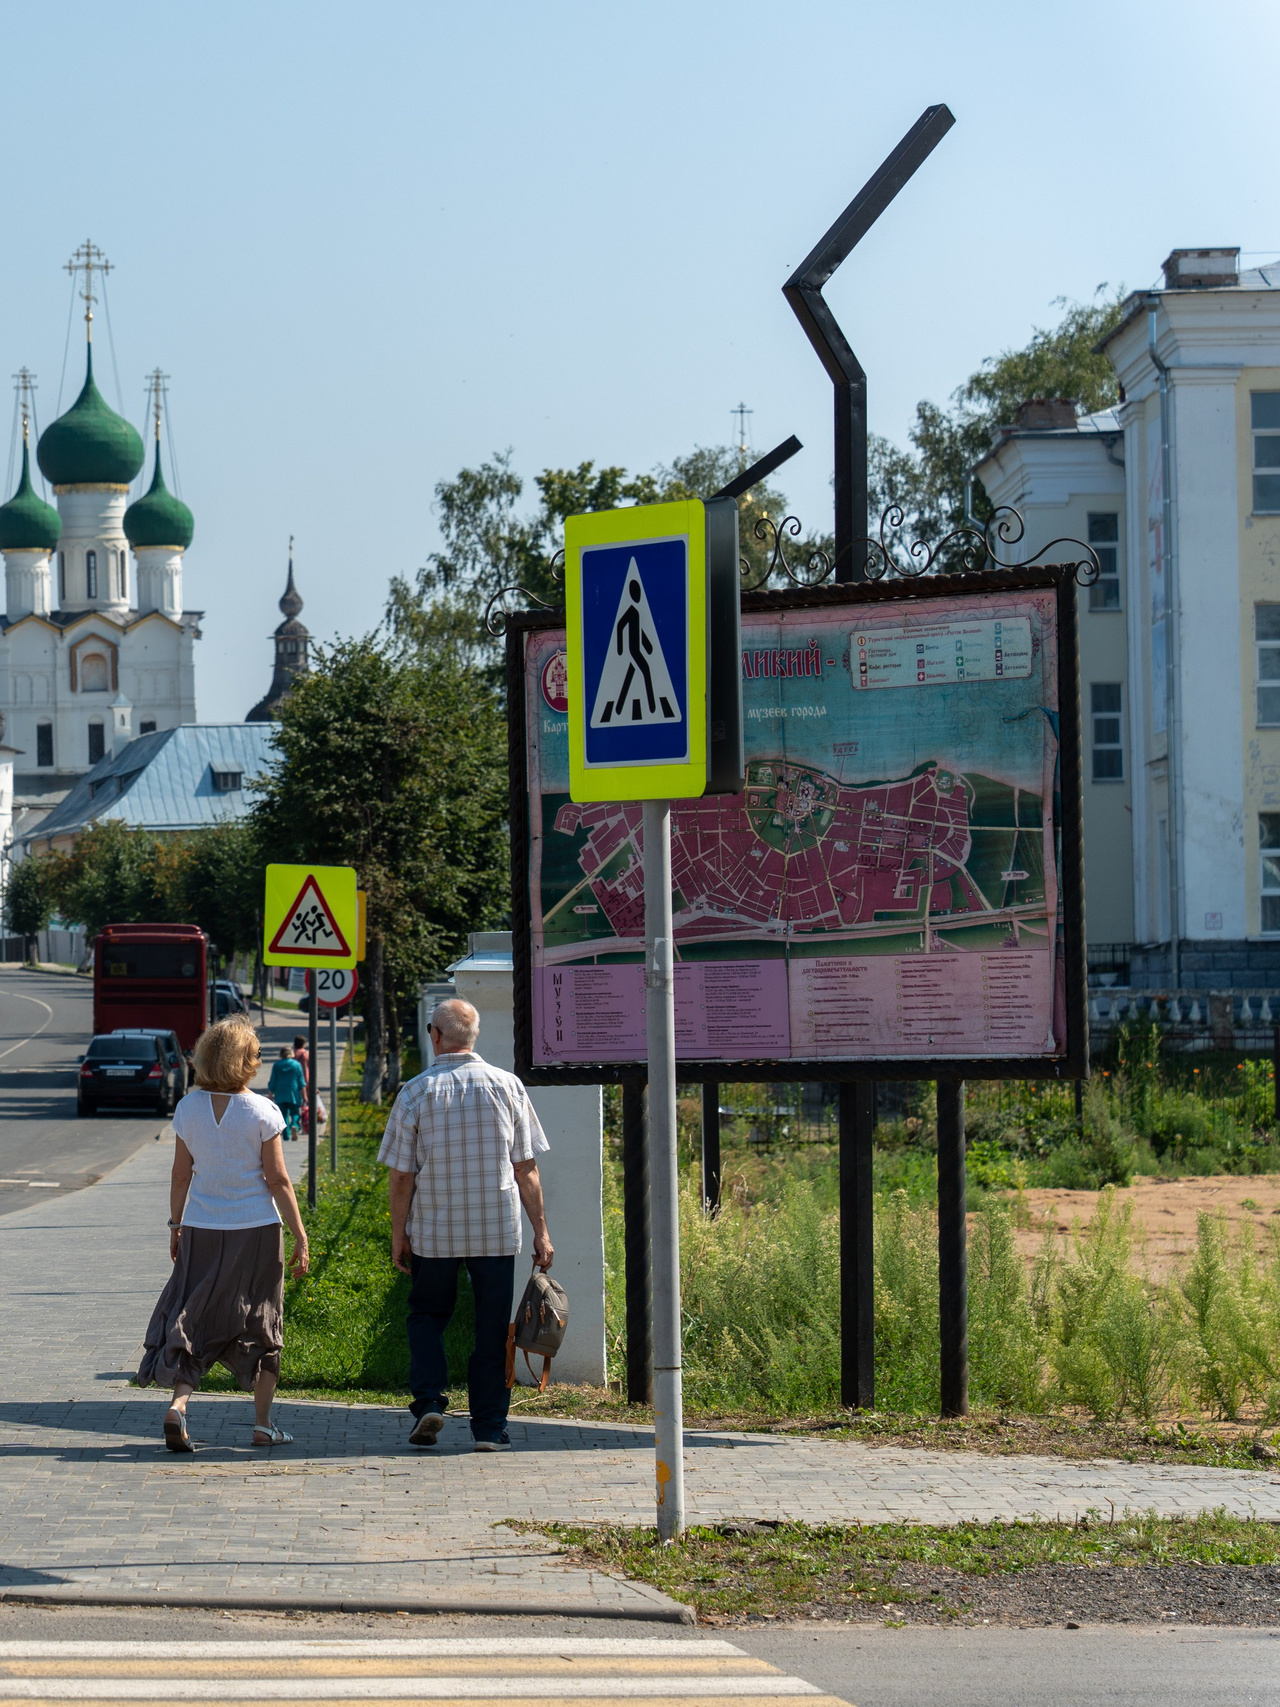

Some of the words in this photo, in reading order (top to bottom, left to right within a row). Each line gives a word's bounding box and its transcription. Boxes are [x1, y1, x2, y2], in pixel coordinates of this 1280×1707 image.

[543, 720, 568, 735] Карт
[748, 707, 788, 722] музеев
[791, 706, 827, 720] города
[318, 970, 345, 990] 20
